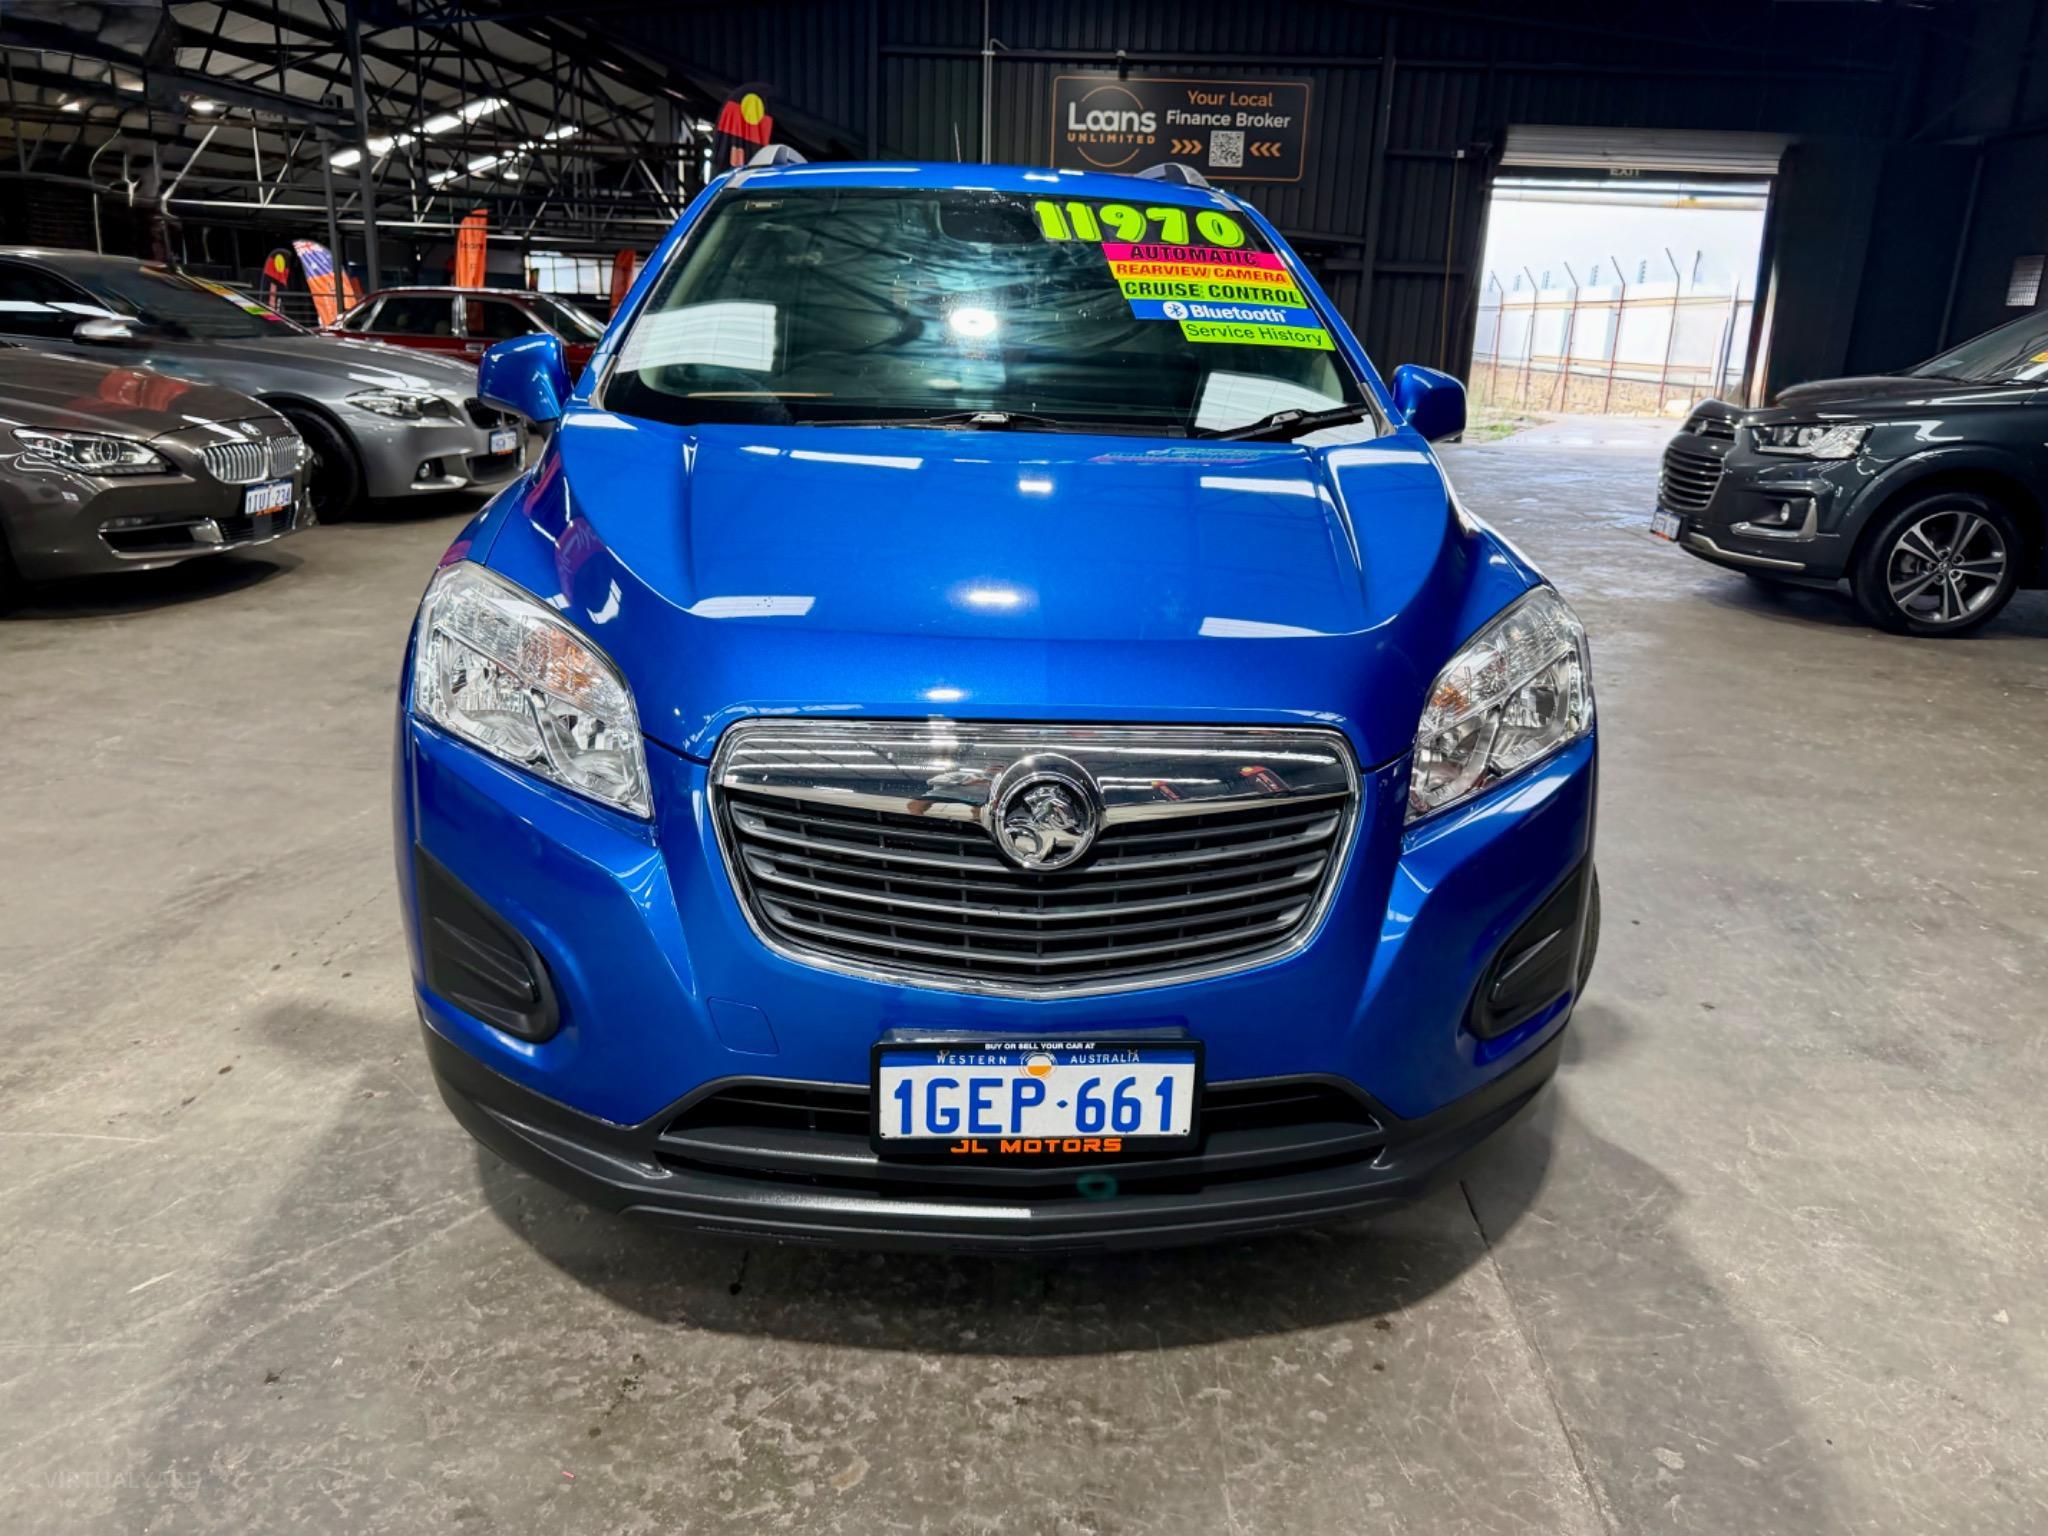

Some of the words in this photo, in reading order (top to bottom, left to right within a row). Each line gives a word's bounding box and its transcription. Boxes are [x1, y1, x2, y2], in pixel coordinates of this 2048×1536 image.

[1187, 90, 1224, 107] Your
[1230, 92, 1273, 108] Local
[1067, 101, 1157, 133] Loans
[1166, 109, 1231, 127] Finance
[1236, 111, 1291, 129] Broker
[1067, 132, 1156, 145] UNLIMITED
[1034, 201, 1246, 248] 11970
[1130, 245, 1257, 266] AUTOMATIC
[1116, 263, 1208, 278] REARVIEW
[1214, 267, 1287, 283] CAMERA
[1125, 281, 1202, 297] CRUISE
[1208, 284, 1301, 304] CONTROL
[1189, 304, 1286, 323] Bluetooth
[1185, 323, 1255, 339] Service
[1258, 327, 1322, 346] History
[985, 1042, 1002, 1050] BUY
[1004, 1042, 1016, 1050] OR
[1018, 1042, 1039, 1050] SELL
[1041, 1042, 1065, 1050] YOUR
[1067, 1042, 1083, 1050] CAR
[1085, 1042, 1095, 1050] AT
[936, 1054, 1007, 1065] WESTERN
[1070, 1053, 1140, 1064] AUSTRALIA
[950, 1139, 989, 1154] JL
[1000, 1138, 1123, 1154] MOTORS
